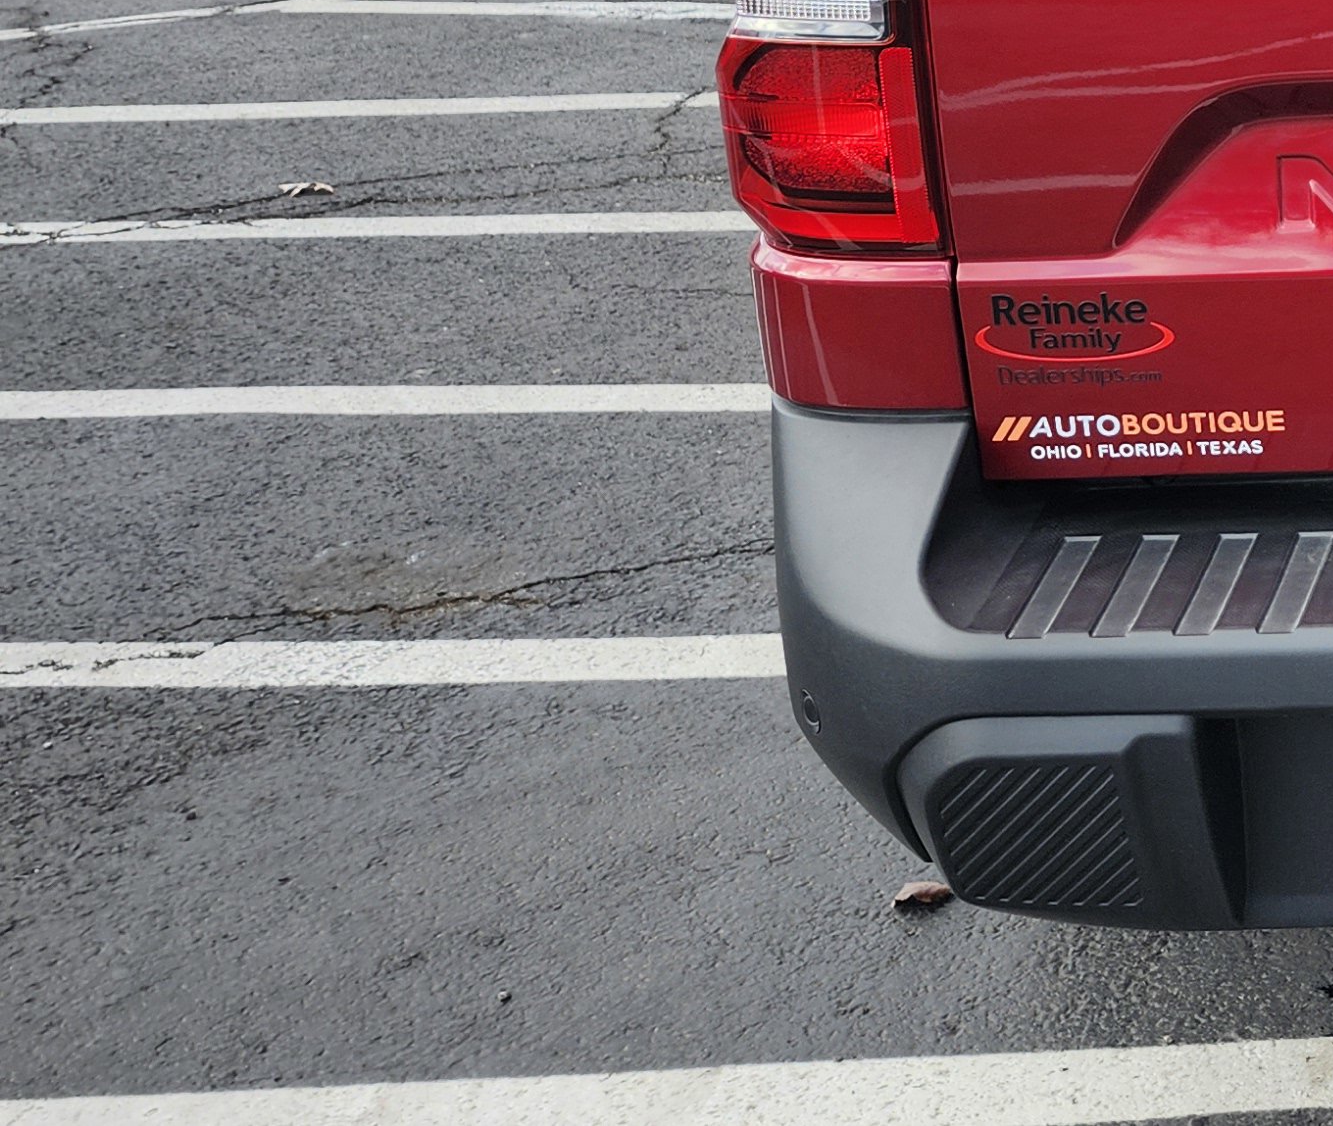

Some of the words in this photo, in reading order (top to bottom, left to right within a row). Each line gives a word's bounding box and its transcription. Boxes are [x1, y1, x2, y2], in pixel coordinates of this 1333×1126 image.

[991, 293, 1148, 327] Reineke
[1029, 327, 1122, 353] Family
[1030, 444, 1083, 460] OHIO
[1097, 441, 1184, 459] FLORIDA
[1195, 439, 1264, 456] TEXAS
